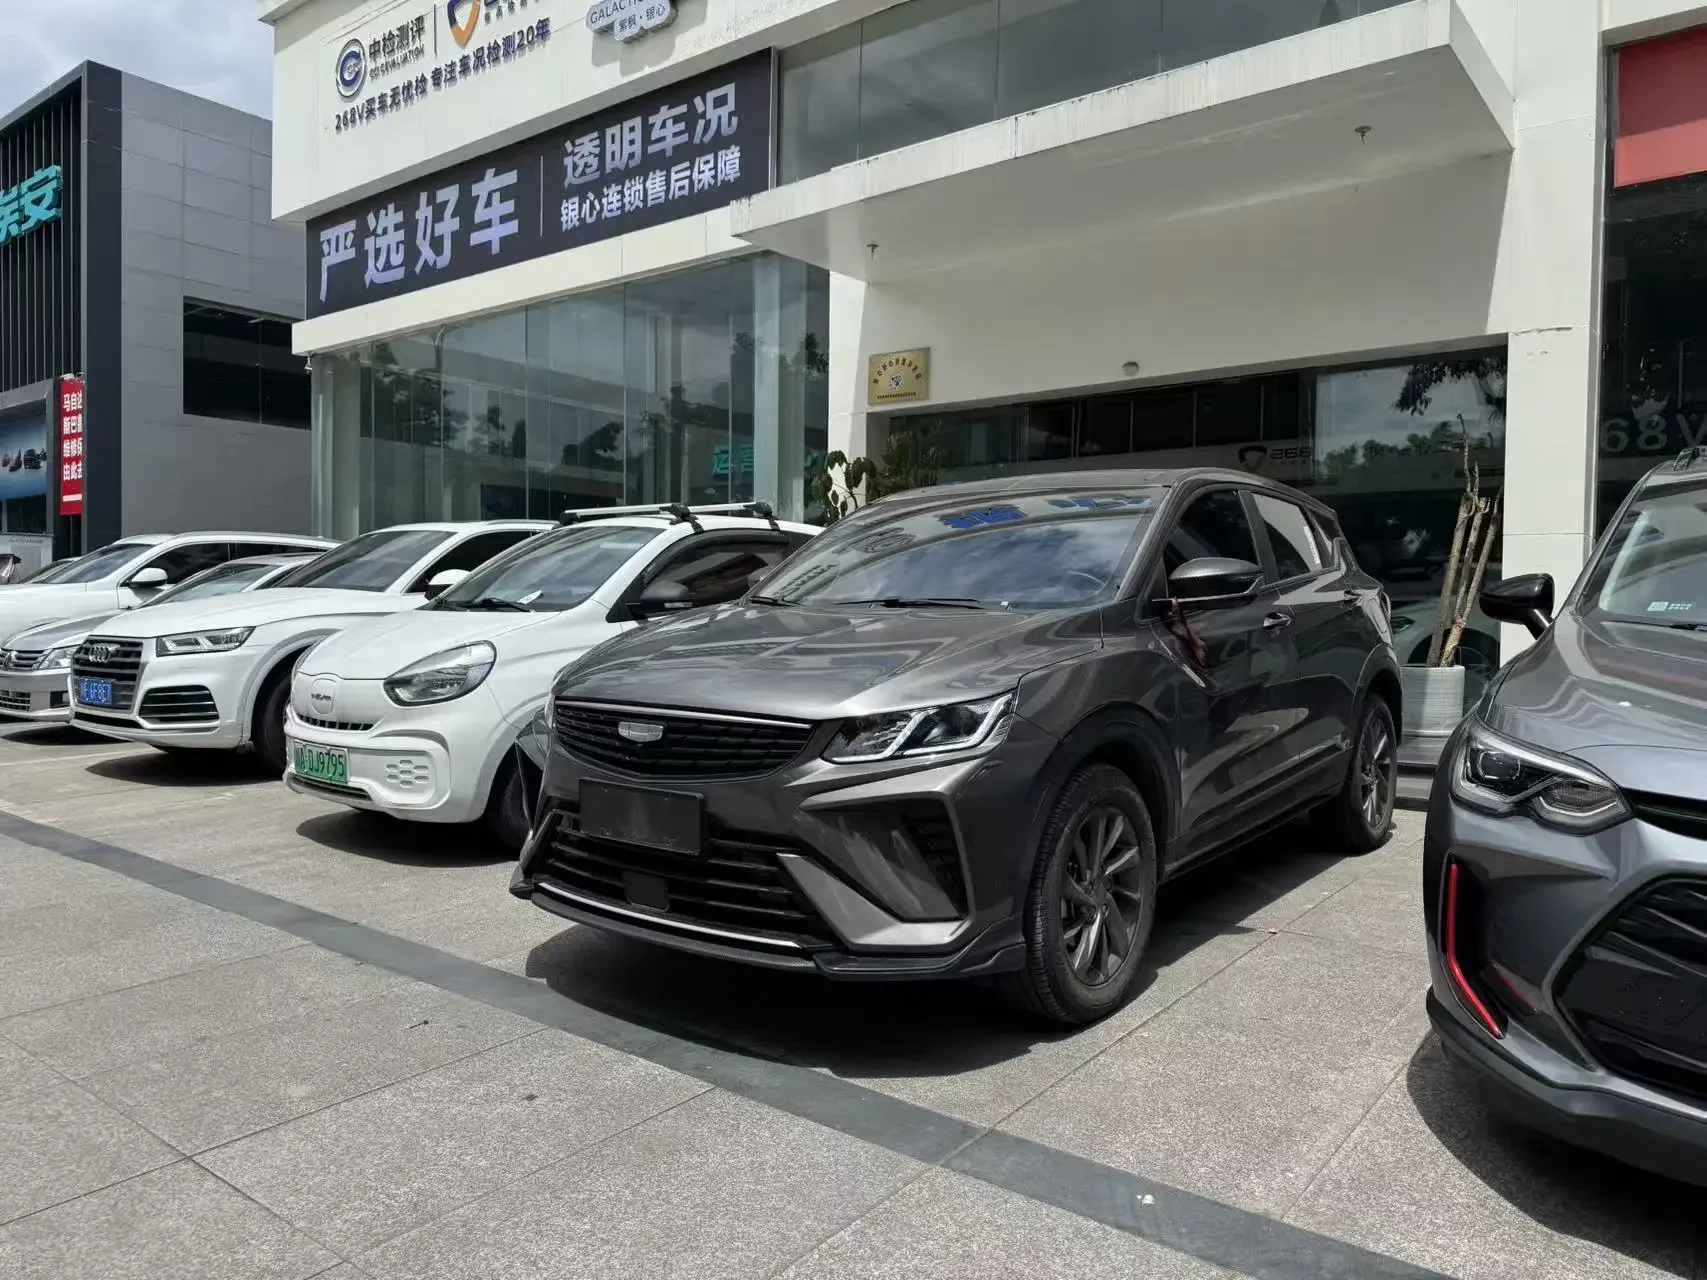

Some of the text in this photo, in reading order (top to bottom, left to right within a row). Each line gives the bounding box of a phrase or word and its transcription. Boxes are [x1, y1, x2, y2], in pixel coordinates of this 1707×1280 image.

[369, 15, 424, 62] 中检测评
[563, 82, 738, 189] 透明车况
[319, 167, 520, 302] 严选好车
[560, 144, 741, 232] 银心连锁售后保障
